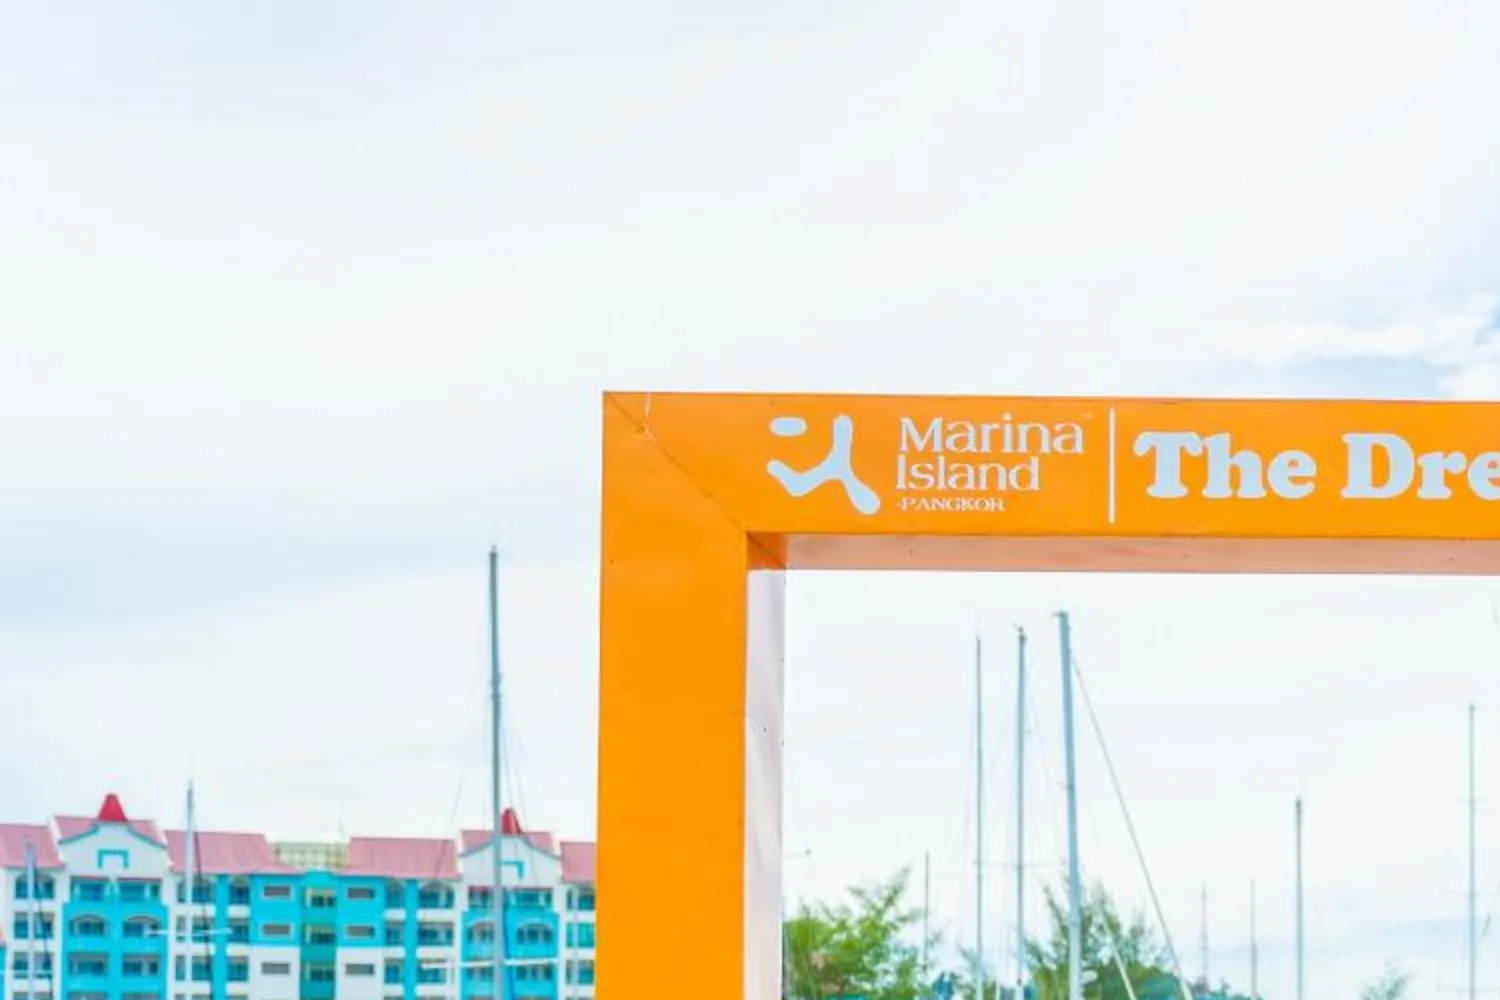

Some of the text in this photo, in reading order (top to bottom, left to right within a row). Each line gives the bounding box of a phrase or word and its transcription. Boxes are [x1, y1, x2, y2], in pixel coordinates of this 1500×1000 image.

[900, 413, 1085, 453] Marina
[896, 455, 1041, 491] Island
[1133, 431, 1317, 497] The
